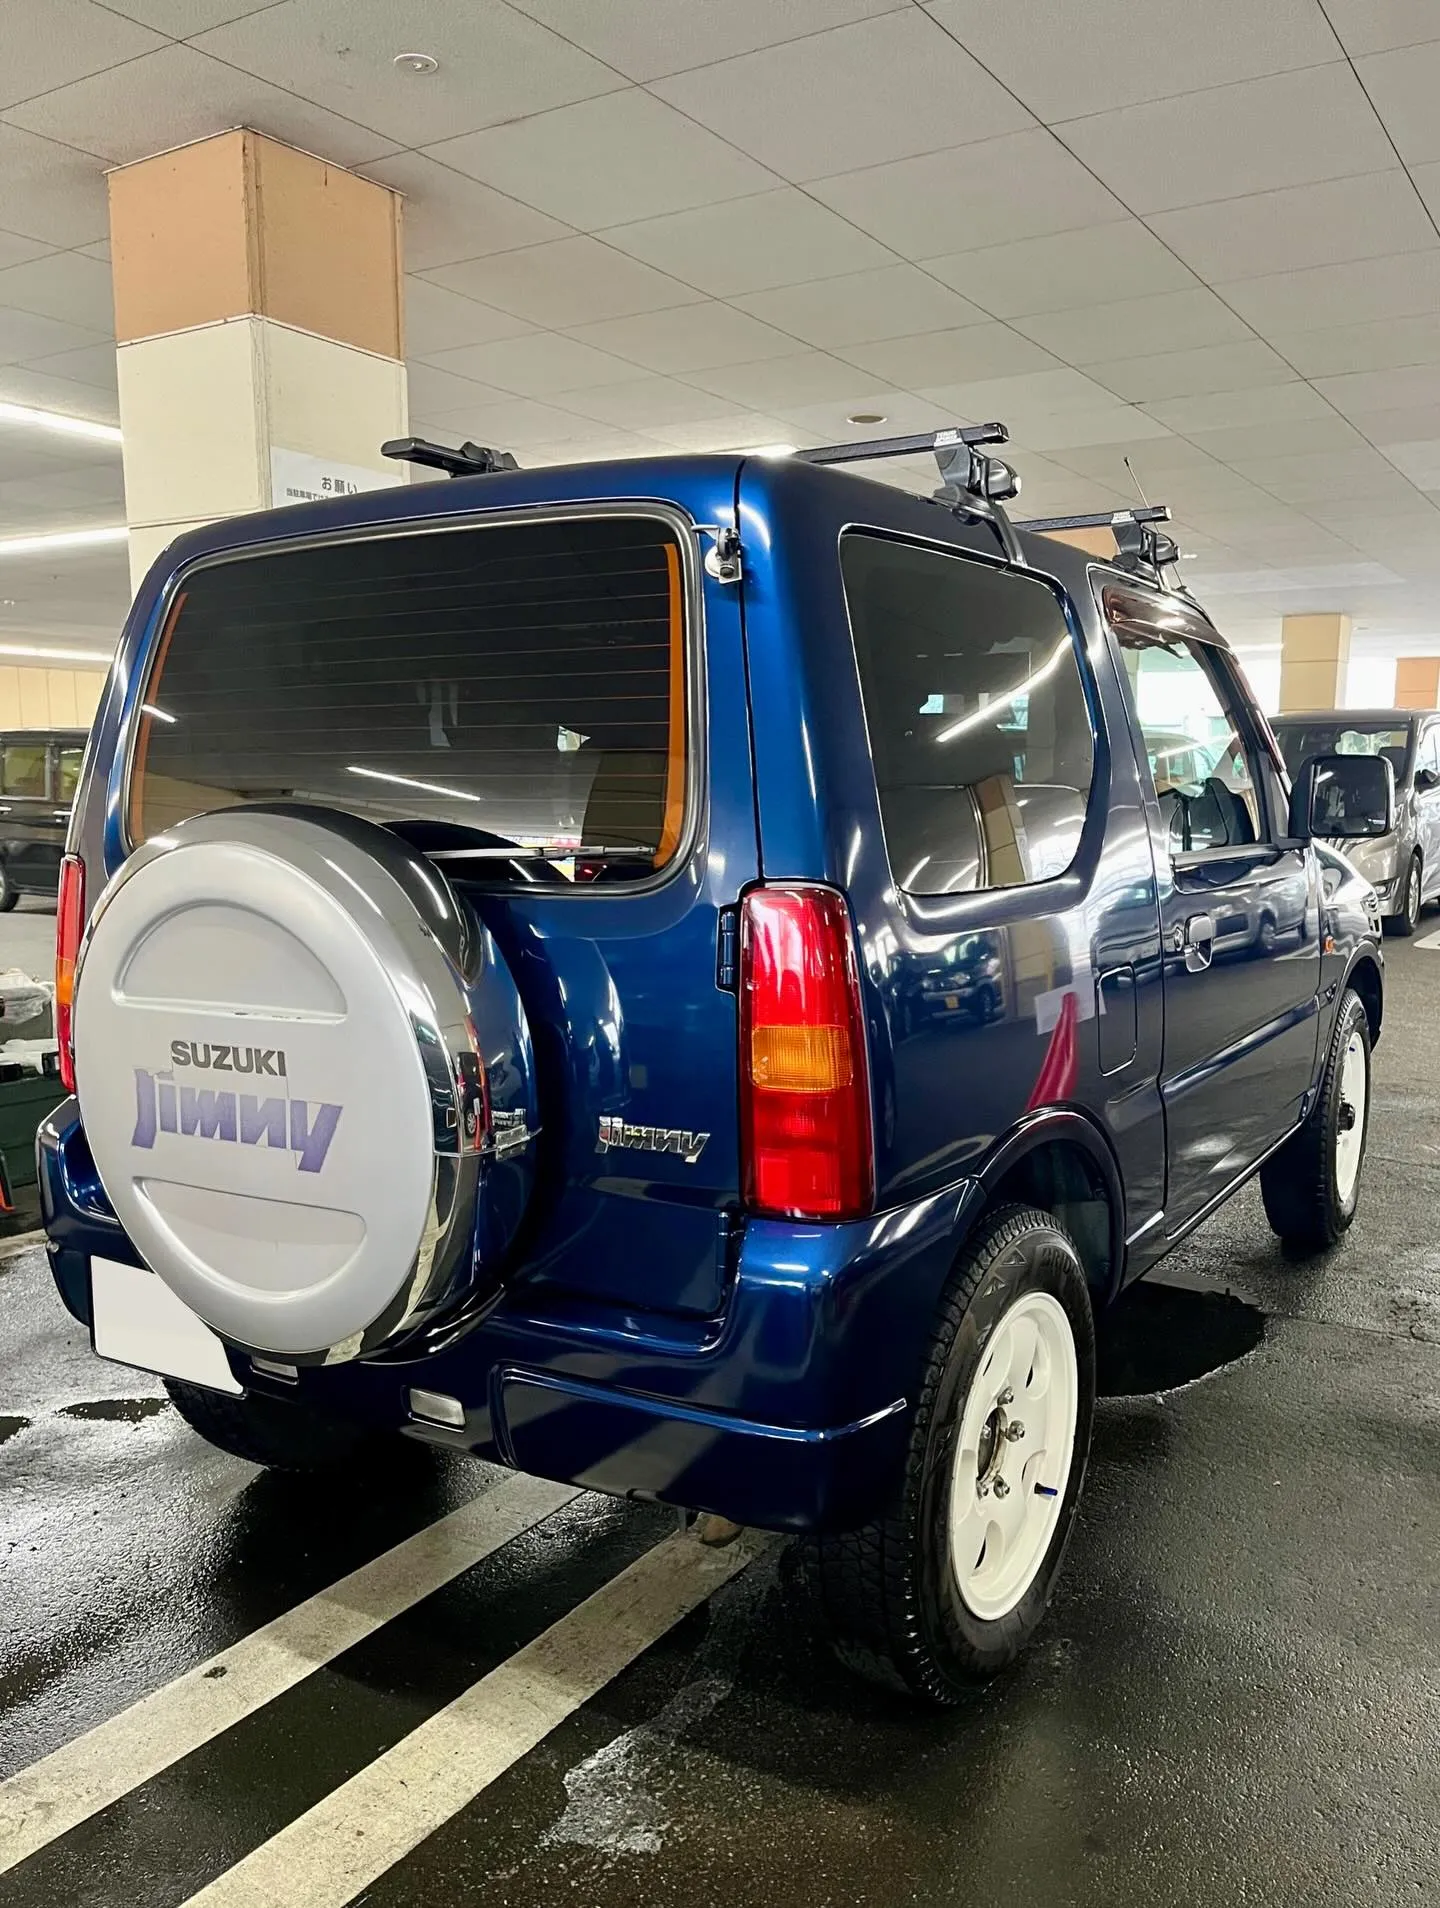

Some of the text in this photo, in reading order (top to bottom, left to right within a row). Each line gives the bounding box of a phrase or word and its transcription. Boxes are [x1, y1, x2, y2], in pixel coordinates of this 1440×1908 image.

[321, 476, 358, 495] お願い
[171, 1040, 287, 1077] SUZUKI
[131, 1068, 343, 1173] Jimny
